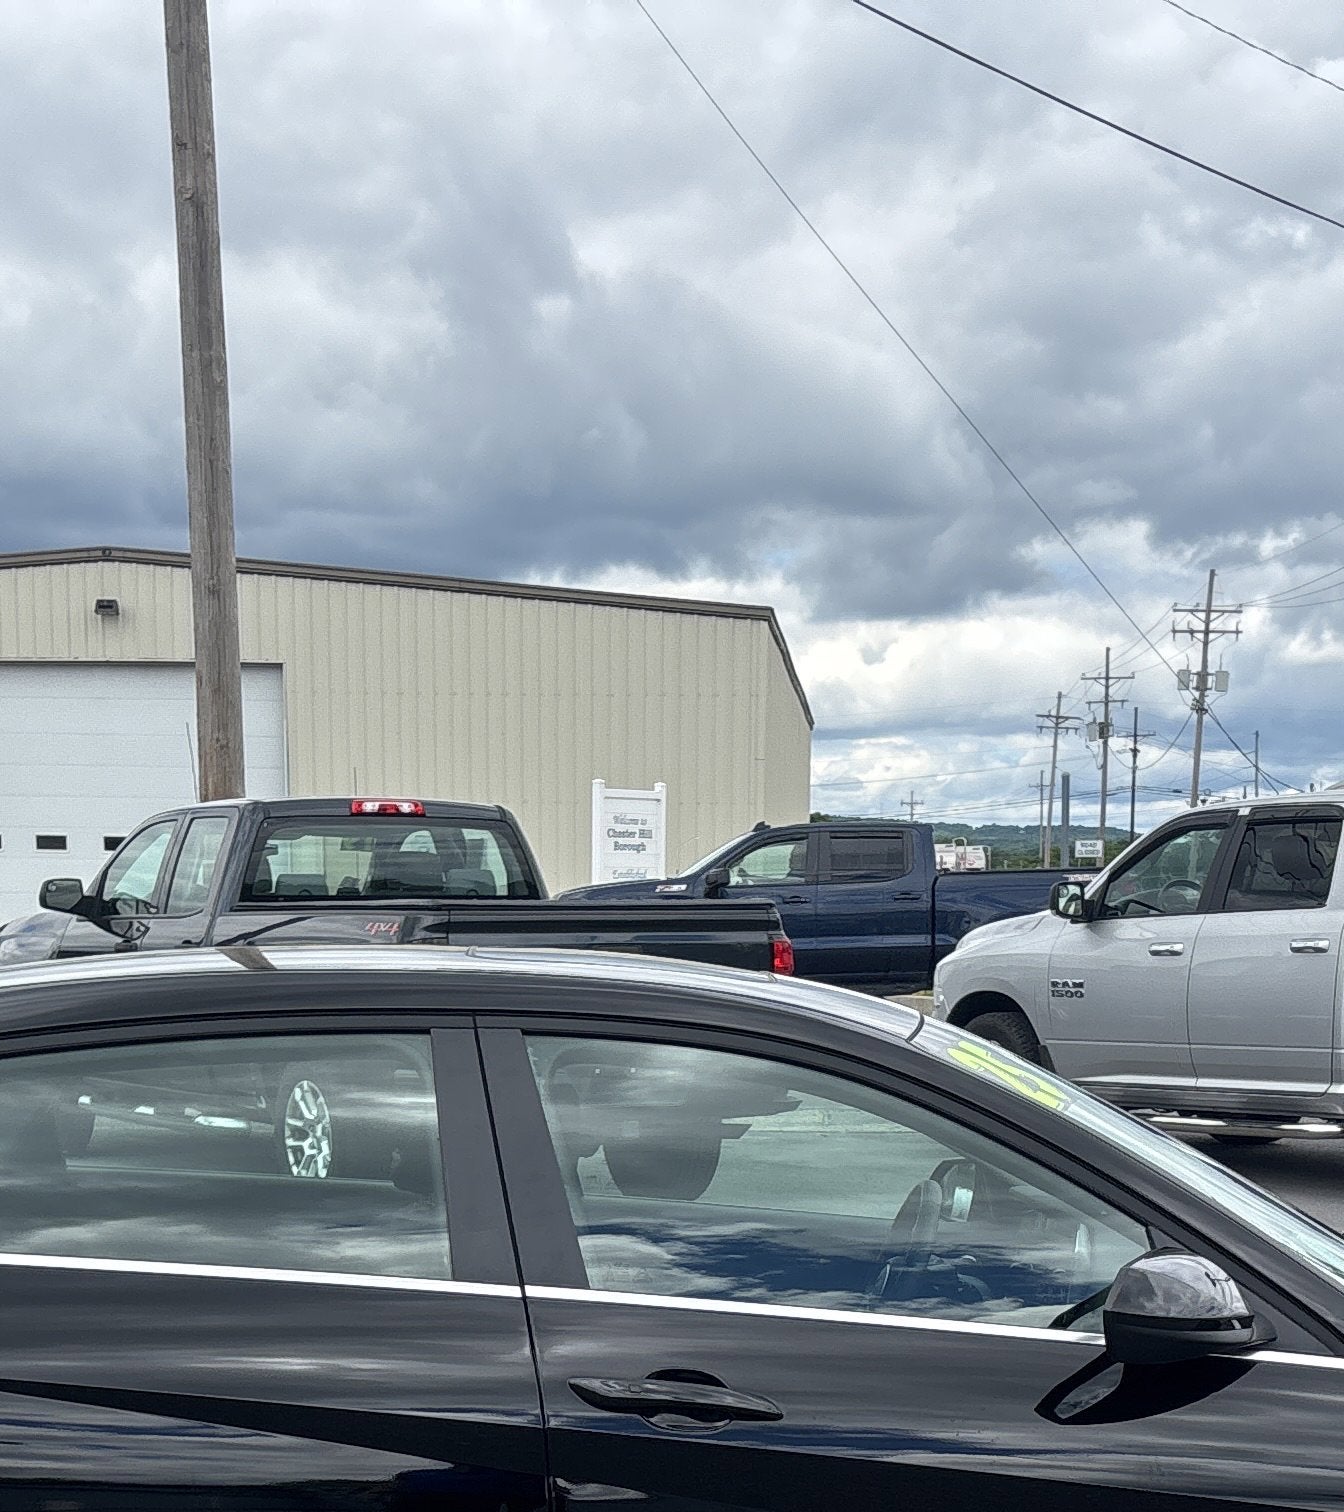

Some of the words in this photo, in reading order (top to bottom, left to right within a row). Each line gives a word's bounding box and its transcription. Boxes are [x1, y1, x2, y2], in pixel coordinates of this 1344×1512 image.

[607, 828, 637, 838] Chester
[638, 829, 652, 839] Hill
[613, 841, 646, 853] Borough
[1050, 979, 1084, 988] RAM
[1050, 989, 1085, 998] 1500
